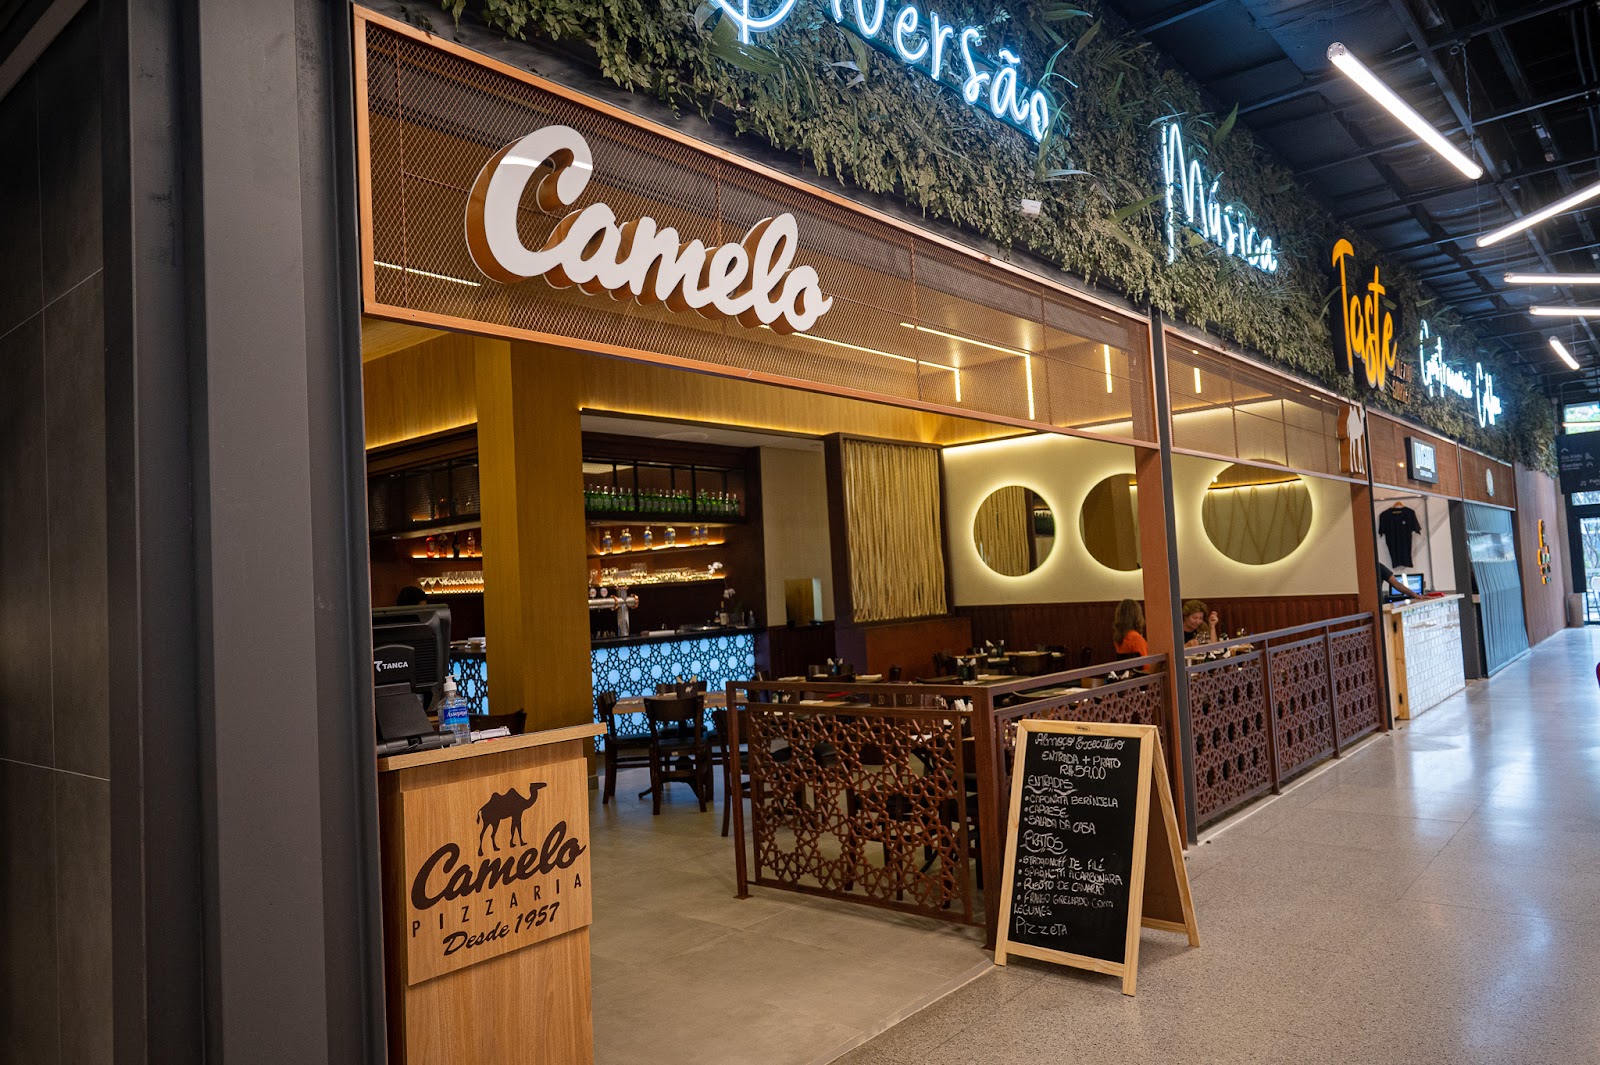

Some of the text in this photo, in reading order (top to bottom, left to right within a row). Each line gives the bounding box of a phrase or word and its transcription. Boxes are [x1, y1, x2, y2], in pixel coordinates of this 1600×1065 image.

[707, 0, 1050, 143] versão
[1161, 122, 1278, 273] Música
[466, 125, 833, 333] Camelo
[1332, 238, 1397, 391] Taste
[382, 661, 409, 670] TANCA
[1041, 750, 1079, 765] ENTRADA
[1093, 756, 1121, 769] PRATO
[1028, 815, 1096, 835] SALADA DA CASA
[1029, 805, 1069, 818] CAPRESE
[1023, 829, 1064, 850] PRATOS
[411, 821, 587, 910] Camelo
[1068, 857, 1083, 870] DE
[1056, 881, 1069, 890] DE
[412, 873, 582, 938] PIZZARIA
[442, 902, 560, 956] Desde 1957
